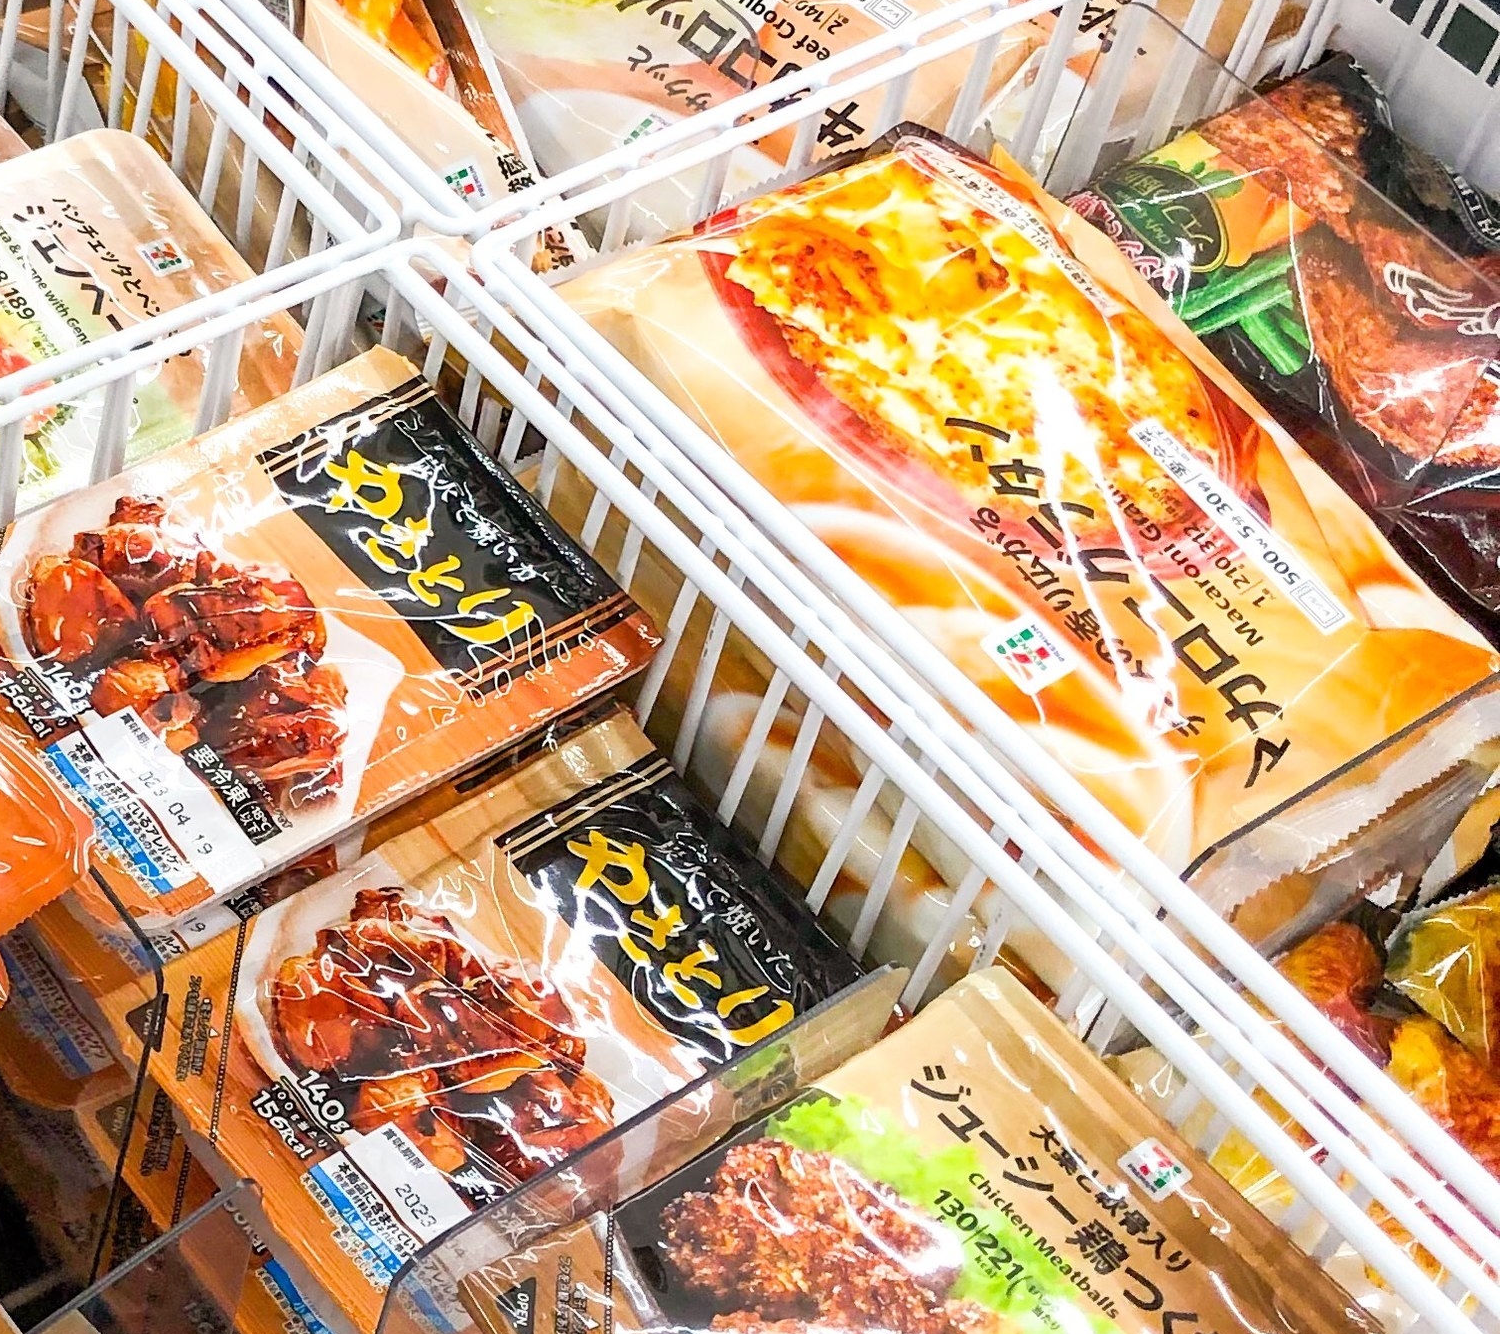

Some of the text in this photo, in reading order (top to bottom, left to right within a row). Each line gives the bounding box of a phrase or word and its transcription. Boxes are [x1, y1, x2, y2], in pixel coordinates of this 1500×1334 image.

[627, 44, 713, 114] サクッと
[792, 35, 831, 61] eef
[2, 286, 36, 321] 189
[45, 289, 71, 318] with
[324, 447, 543, 646] やきとり
[1214, 555, 1247, 590] 210
[945, 416, 1291, 789] マカロニグラタン
[1164, 543, 1264, 647] Macaroni
[0, 677, 53, 739] 156kcal
[188, 747, 250, 809] 要冷凍
[565, 828, 798, 1047] やきとり
[251, 1090, 315, 1159] 156kcal
[299, 1069, 351, 1134] 140g
[381, 1127, 427, 1170] 賞味期限
[931, 1187, 1021, 1285] 130 221
[966, 1170, 1122, 1321] Chicken Meatballs
[514, 1289, 533, 1331] OPEN
